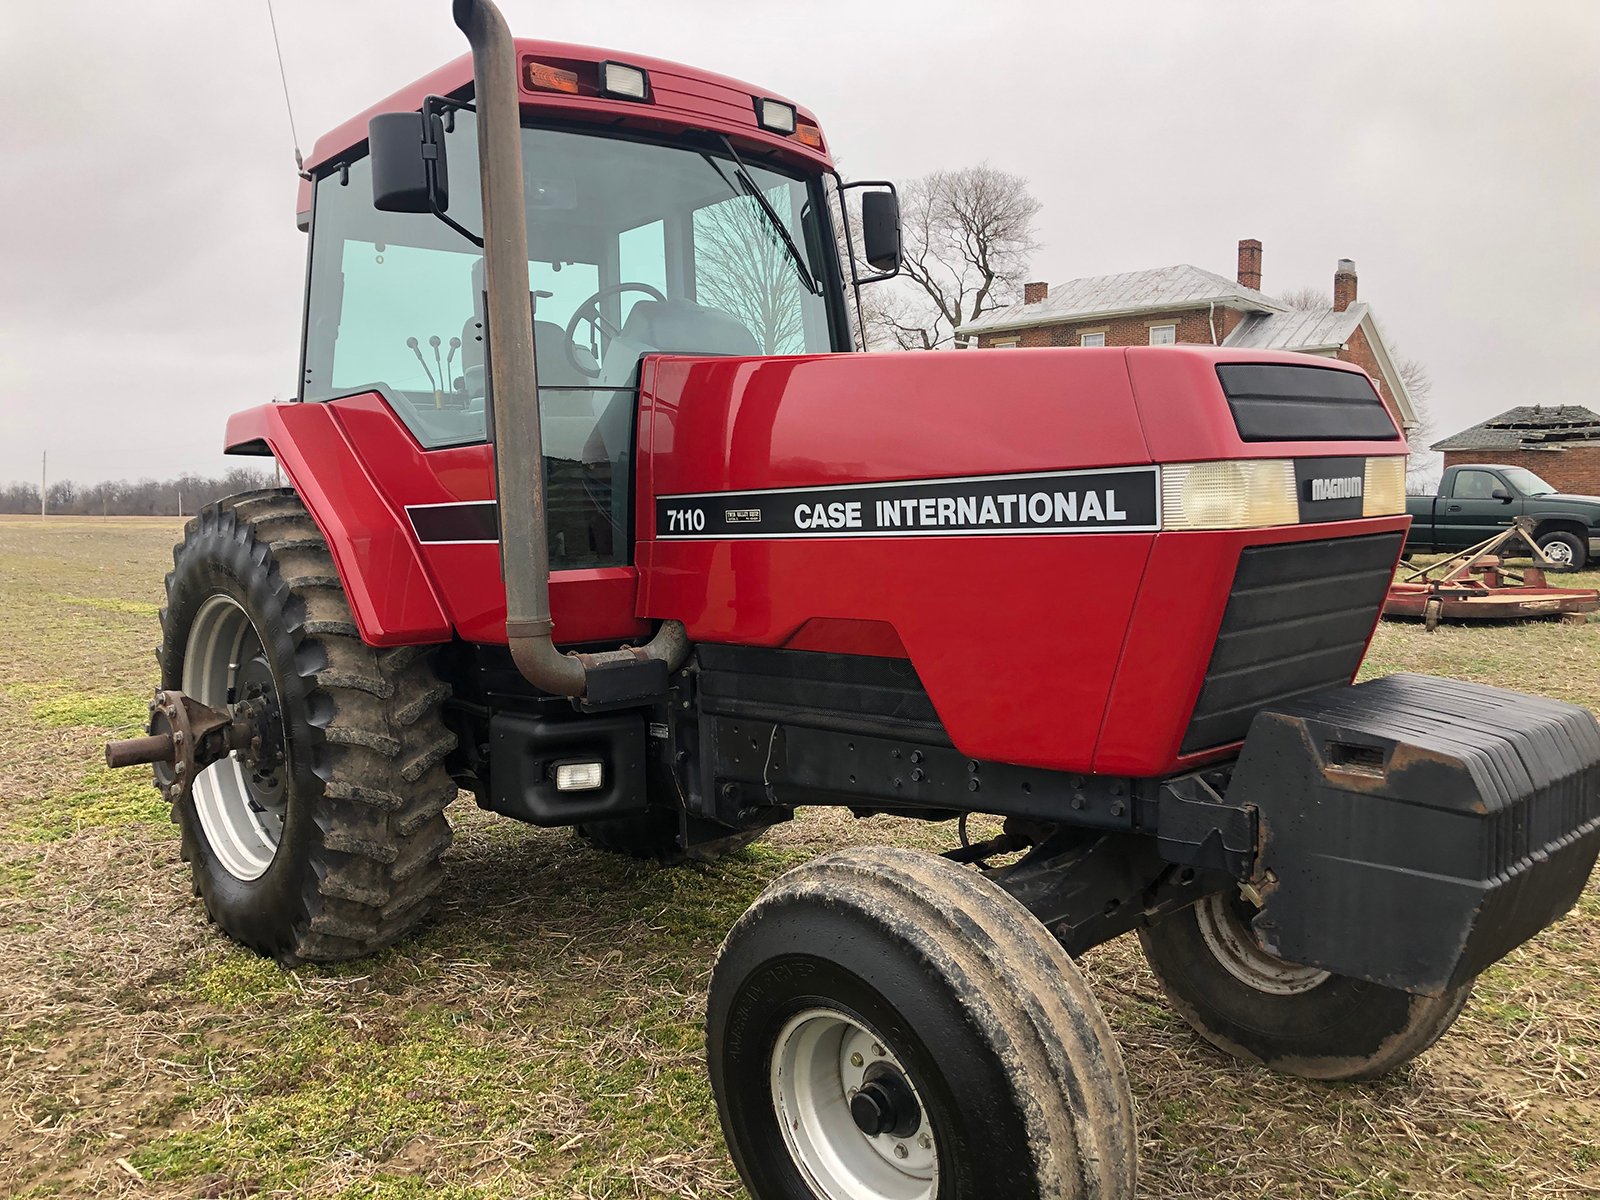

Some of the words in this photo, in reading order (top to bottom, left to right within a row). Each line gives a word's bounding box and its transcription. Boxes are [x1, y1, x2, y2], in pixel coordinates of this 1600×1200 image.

[1311, 476, 1362, 501] MAGNUM
[666, 508, 705, 532] 7110
[794, 501, 863, 529] CASE
[875, 489, 1127, 527] INTERNATIONAL
